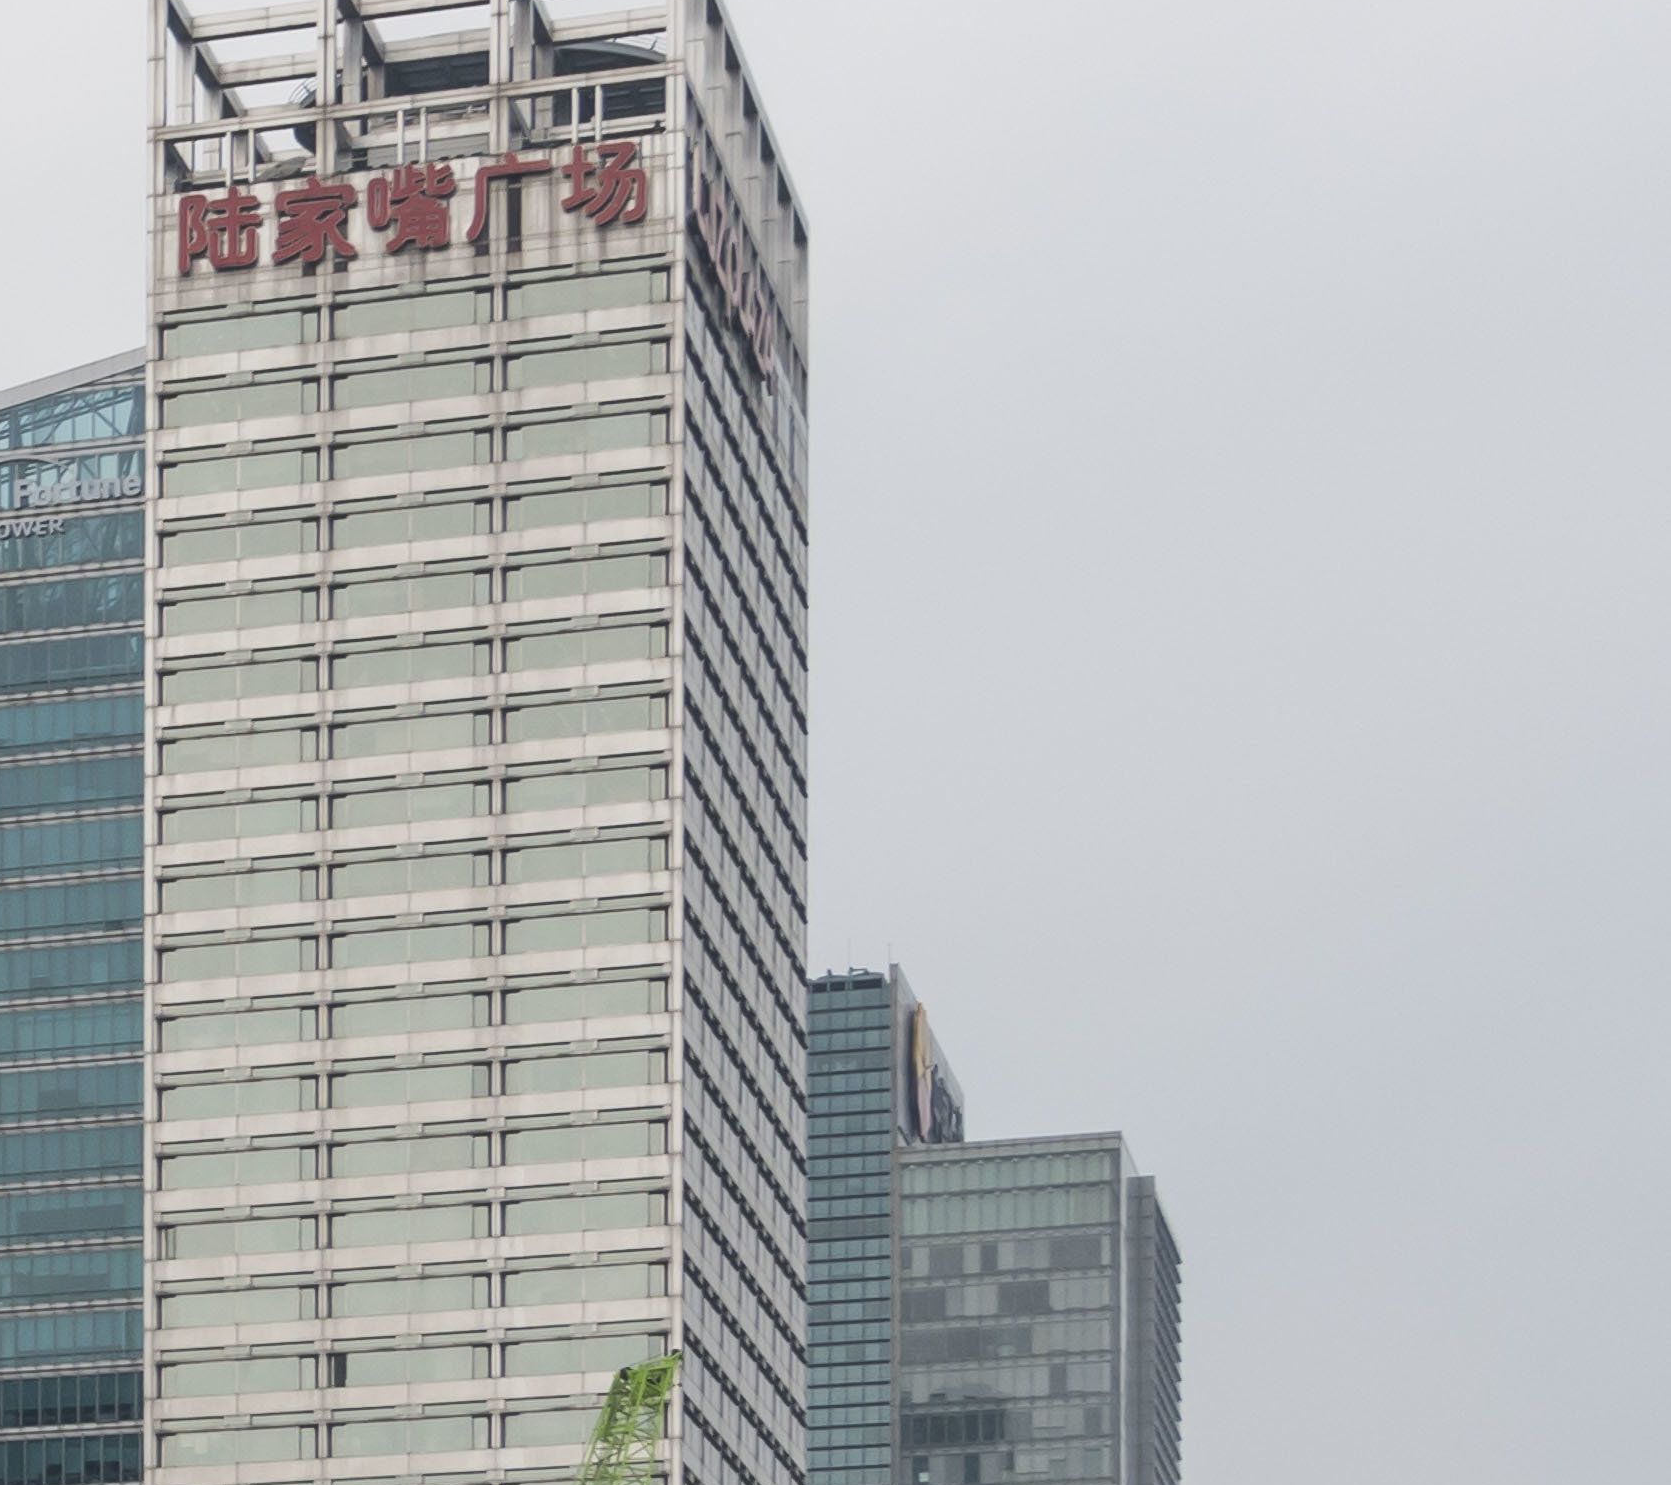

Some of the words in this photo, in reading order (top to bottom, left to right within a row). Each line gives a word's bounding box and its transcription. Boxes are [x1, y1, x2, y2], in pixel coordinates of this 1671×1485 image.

[178, 140, 648, 274] 陆家嘴广场
[13, 475, 142, 508] Fortune
